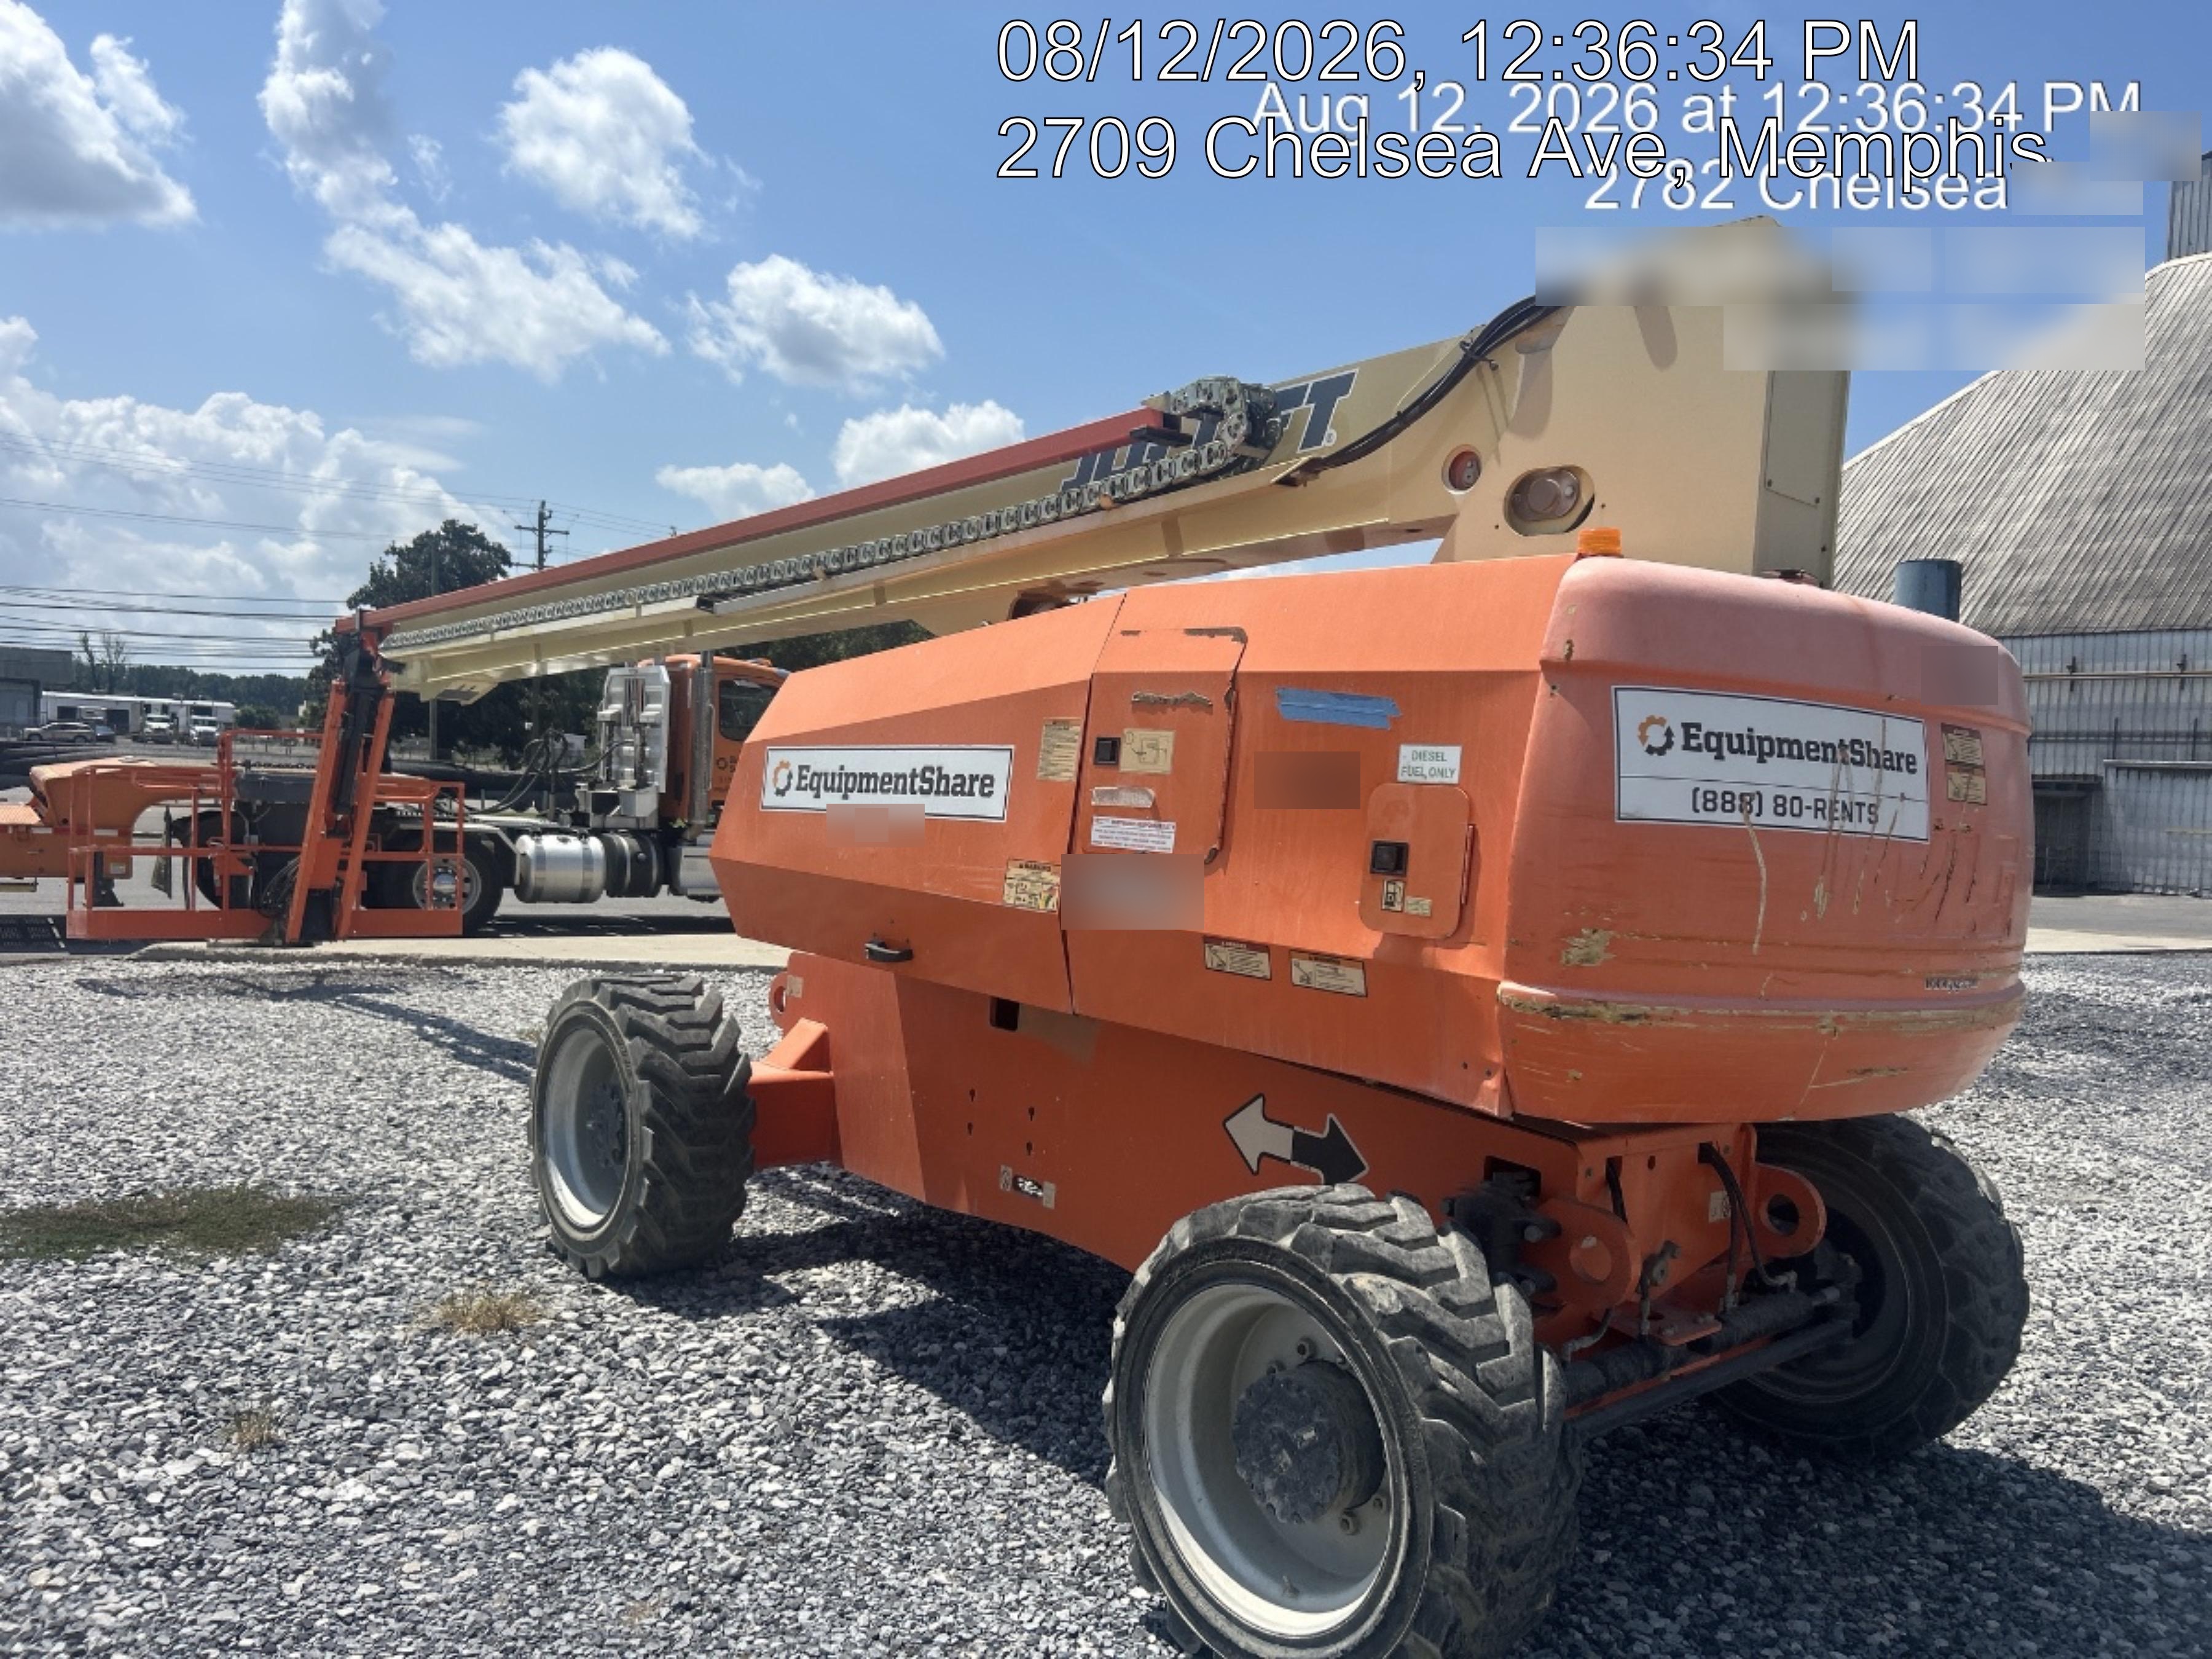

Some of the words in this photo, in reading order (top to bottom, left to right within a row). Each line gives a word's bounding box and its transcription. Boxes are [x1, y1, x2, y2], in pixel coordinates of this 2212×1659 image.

[1412, 750, 1447, 762] DIESEL
[1681, 722, 1918, 774] EquipmentShare
[796, 764, 995, 799] EquipmentShare
[1429, 766, 1456, 778] ONLY
[1692, 786, 1763, 817] (888)
[1773, 794, 1879, 825] 80-RENTS
